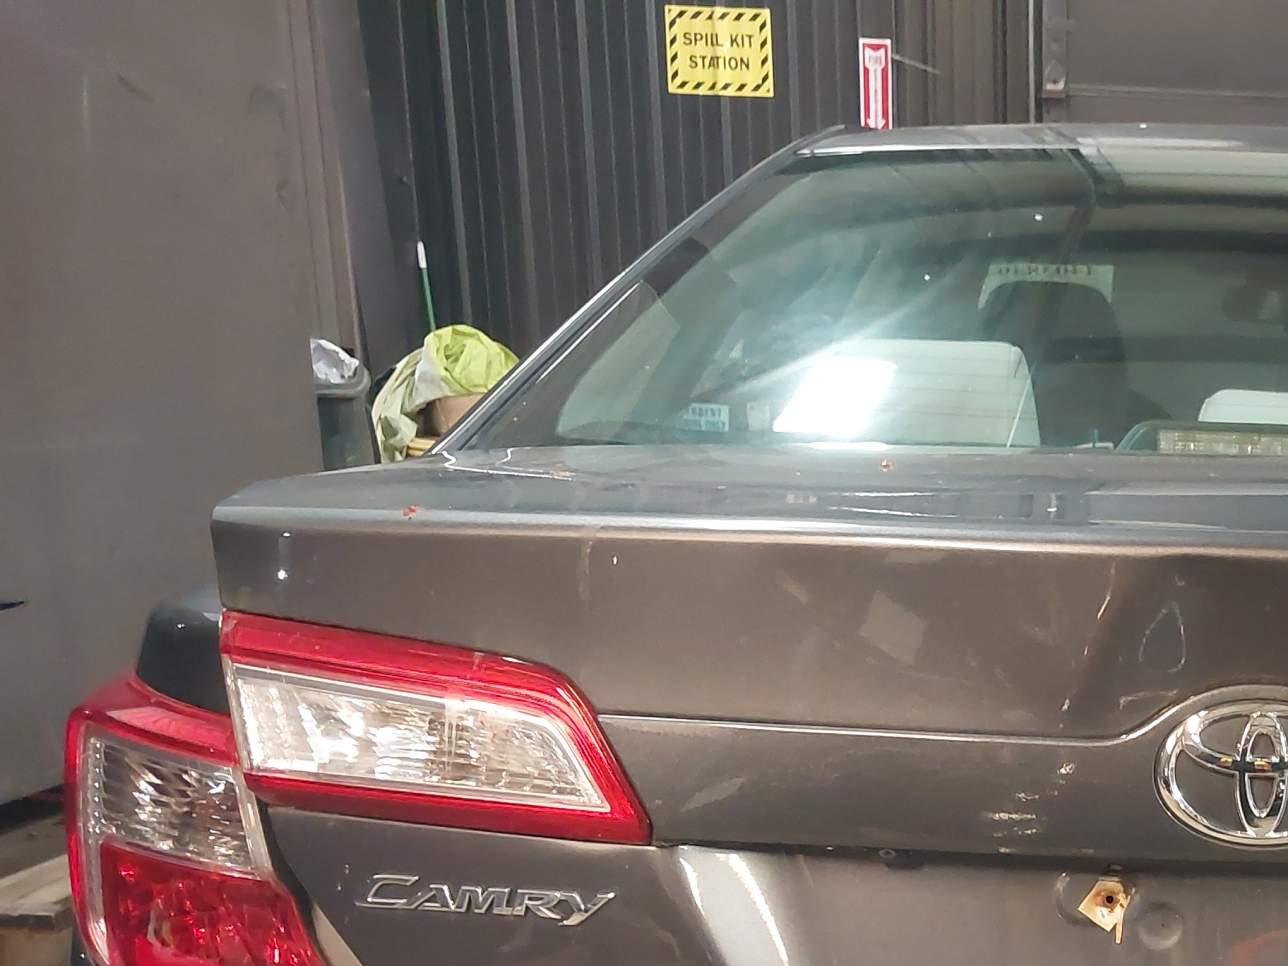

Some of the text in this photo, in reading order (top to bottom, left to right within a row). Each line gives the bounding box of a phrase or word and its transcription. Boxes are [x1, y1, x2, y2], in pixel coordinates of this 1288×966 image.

[682, 32, 754, 48] SPILL KIT
[689, 55, 749, 70] STATION
[355, 874, 615, 926] CAMRY
